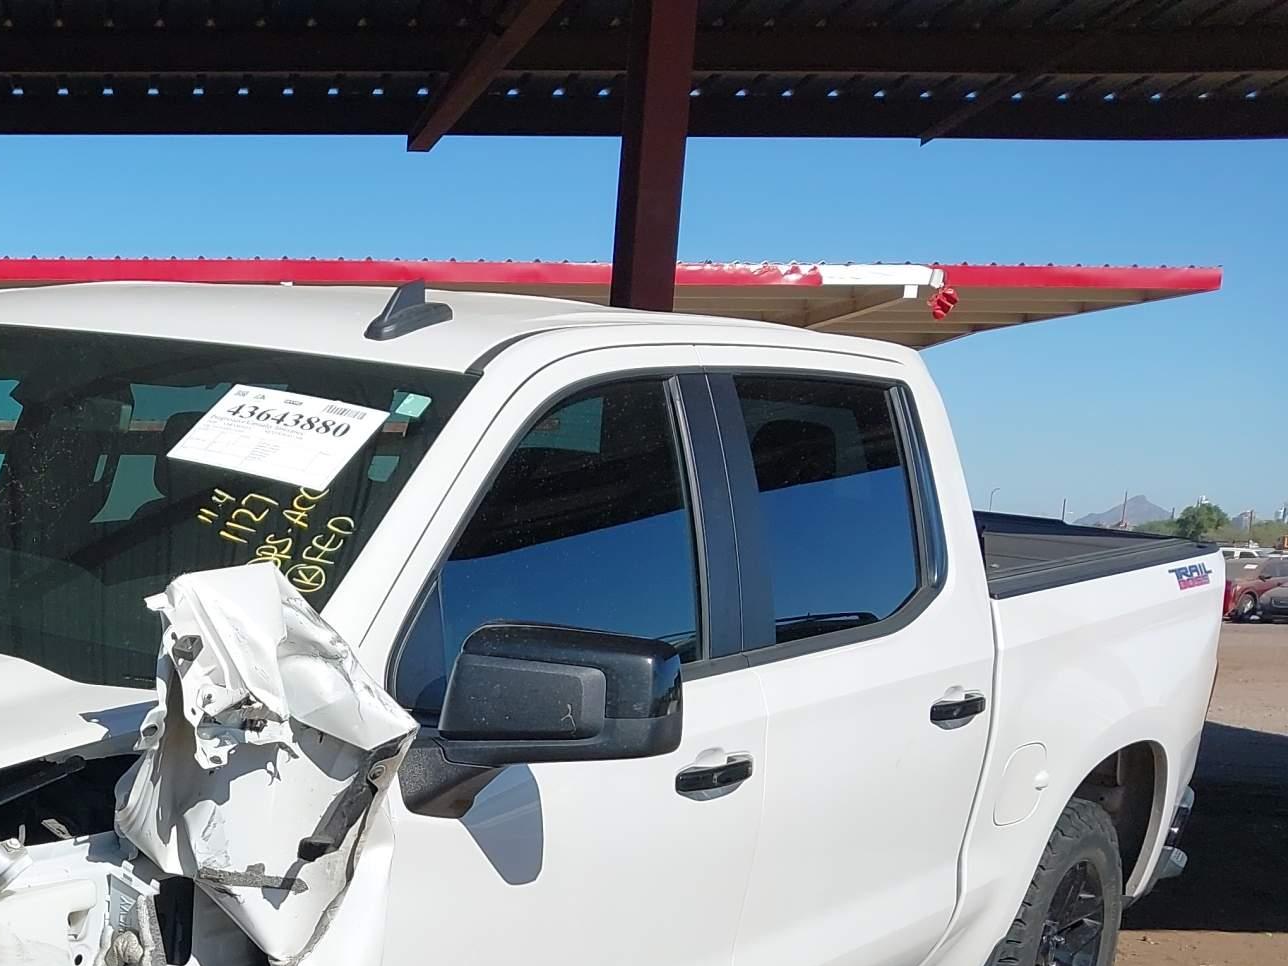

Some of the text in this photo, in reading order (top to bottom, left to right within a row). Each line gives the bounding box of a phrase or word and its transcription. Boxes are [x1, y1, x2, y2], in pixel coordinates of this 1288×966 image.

[226, 402, 351, 438] 43643880
[219, 493, 279, 543] 1127
[1168, 562, 1213, 580] TRAIL
